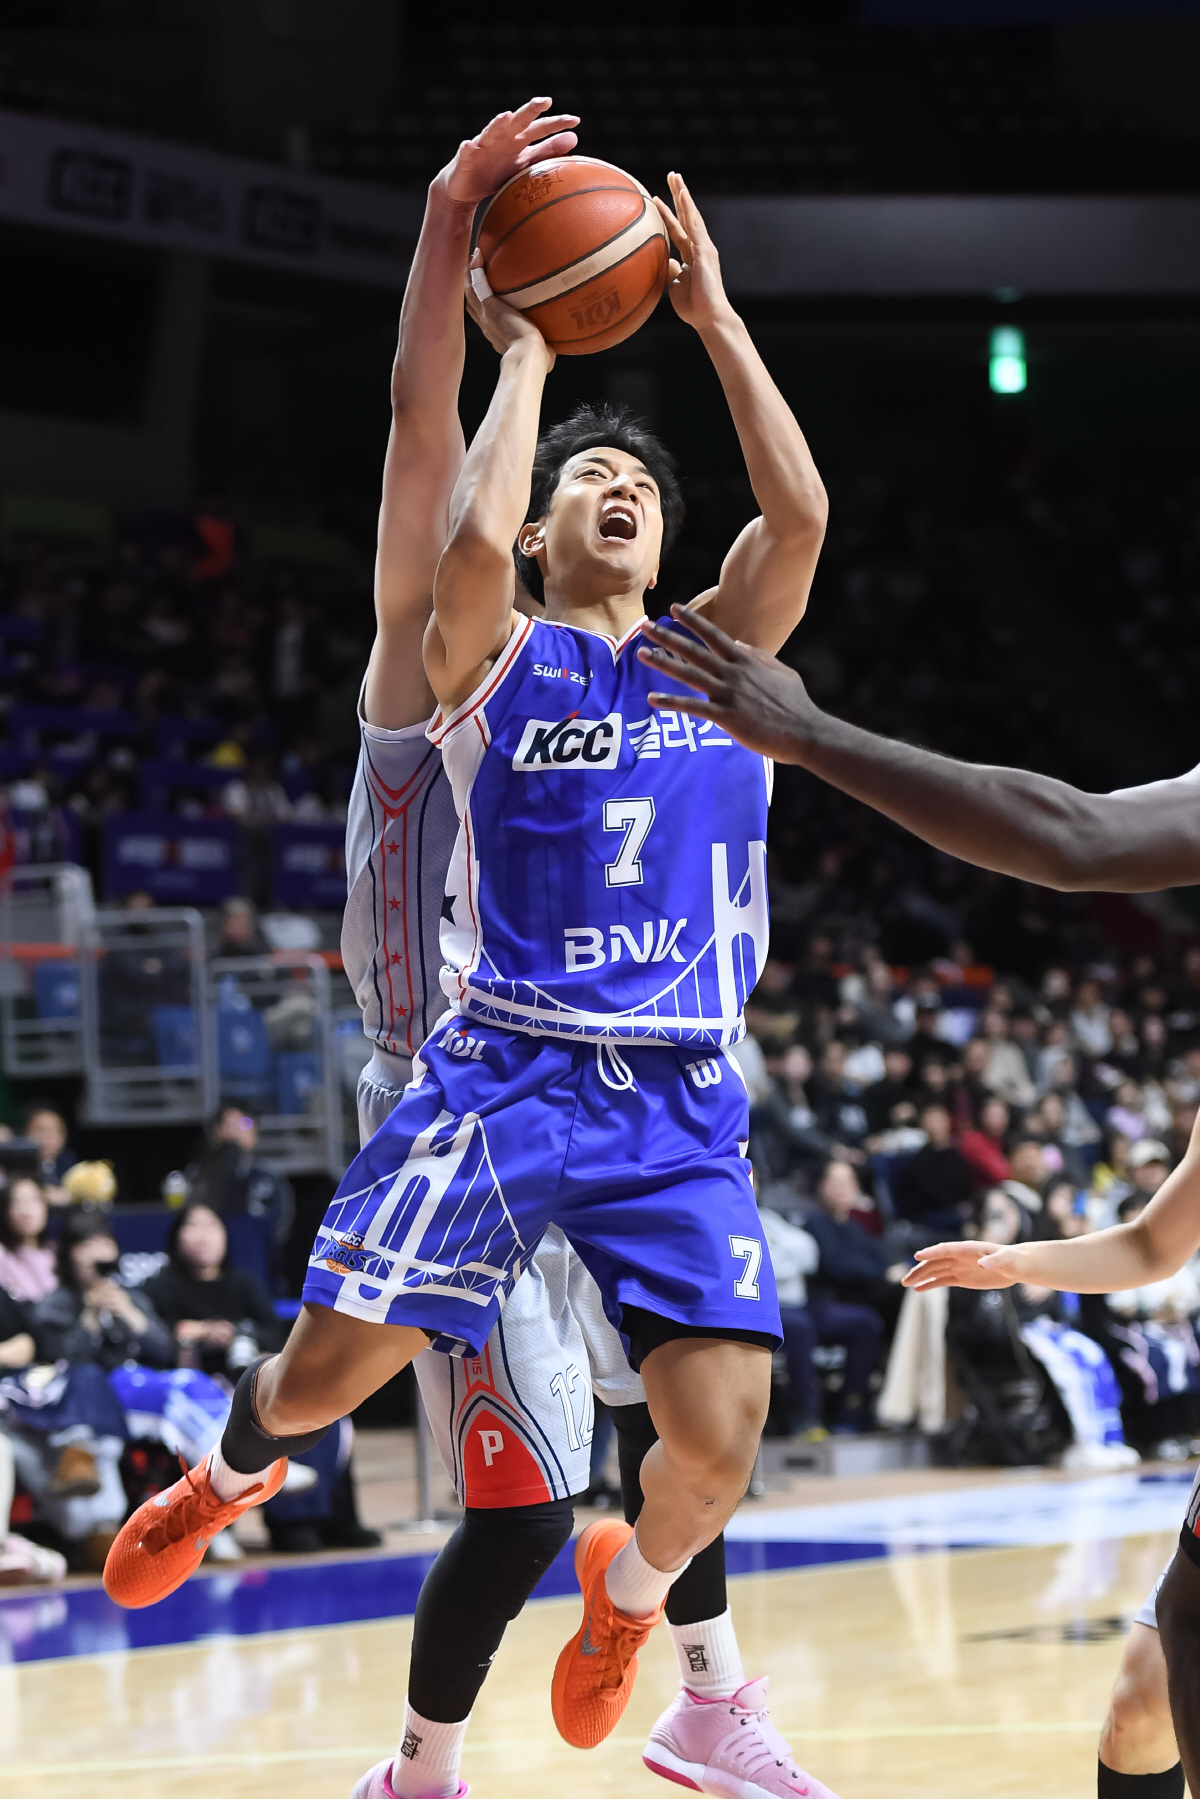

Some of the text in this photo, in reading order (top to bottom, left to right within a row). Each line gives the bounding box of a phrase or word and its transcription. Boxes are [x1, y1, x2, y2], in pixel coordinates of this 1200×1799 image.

[523, 711, 614, 765] KCC
[602, 796, 656, 888] 7
[563, 917, 688, 974] BNK
[436, 1027, 487, 1061] KBL
[341, 1231, 363, 1247] KCC
[728, 1234, 763, 1301] 7
[549, 1363, 594, 1453] 12
[477, 1430, 505, 1467] P
